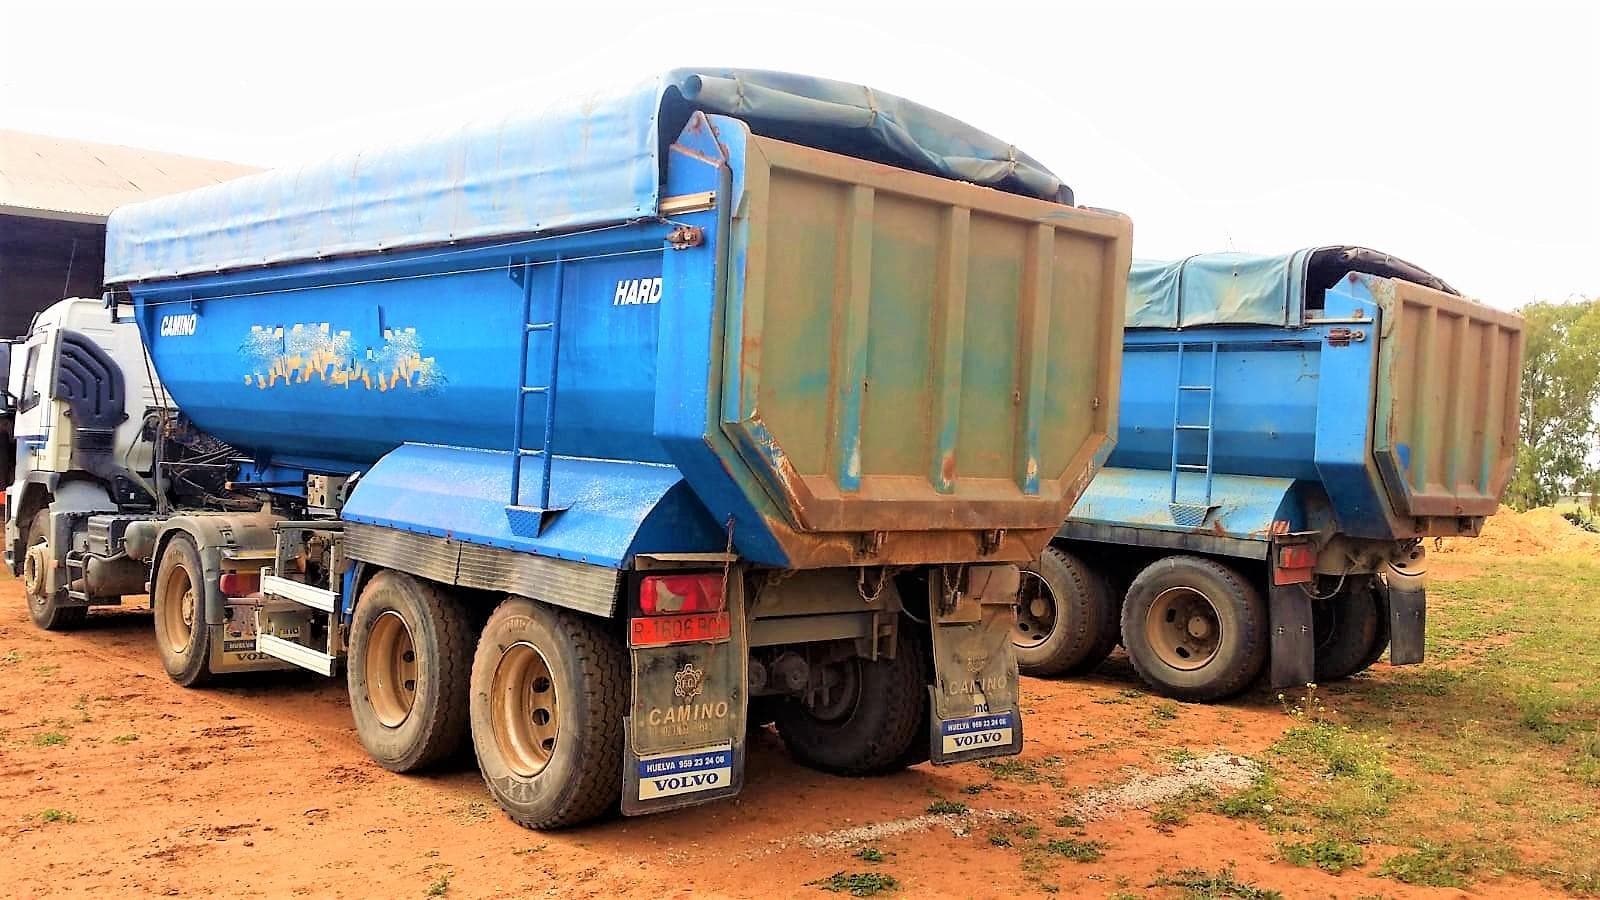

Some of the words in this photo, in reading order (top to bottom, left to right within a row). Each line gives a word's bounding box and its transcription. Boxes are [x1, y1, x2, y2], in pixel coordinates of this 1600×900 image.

[613, 277, 663, 306] HARD
[160, 314, 197, 337] CAMINO
[650, 702, 728, 726] CAMINO
[948, 723, 970, 732] HUELVA
[953, 733, 1001, 746] VOLVO
[646, 761, 676, 773] HUELVA
[678, 760, 693, 769] 959
[694, 758, 703, 767] 23
[705, 756, 714, 765] 24
[653, 773, 719, 791] VOLVO
